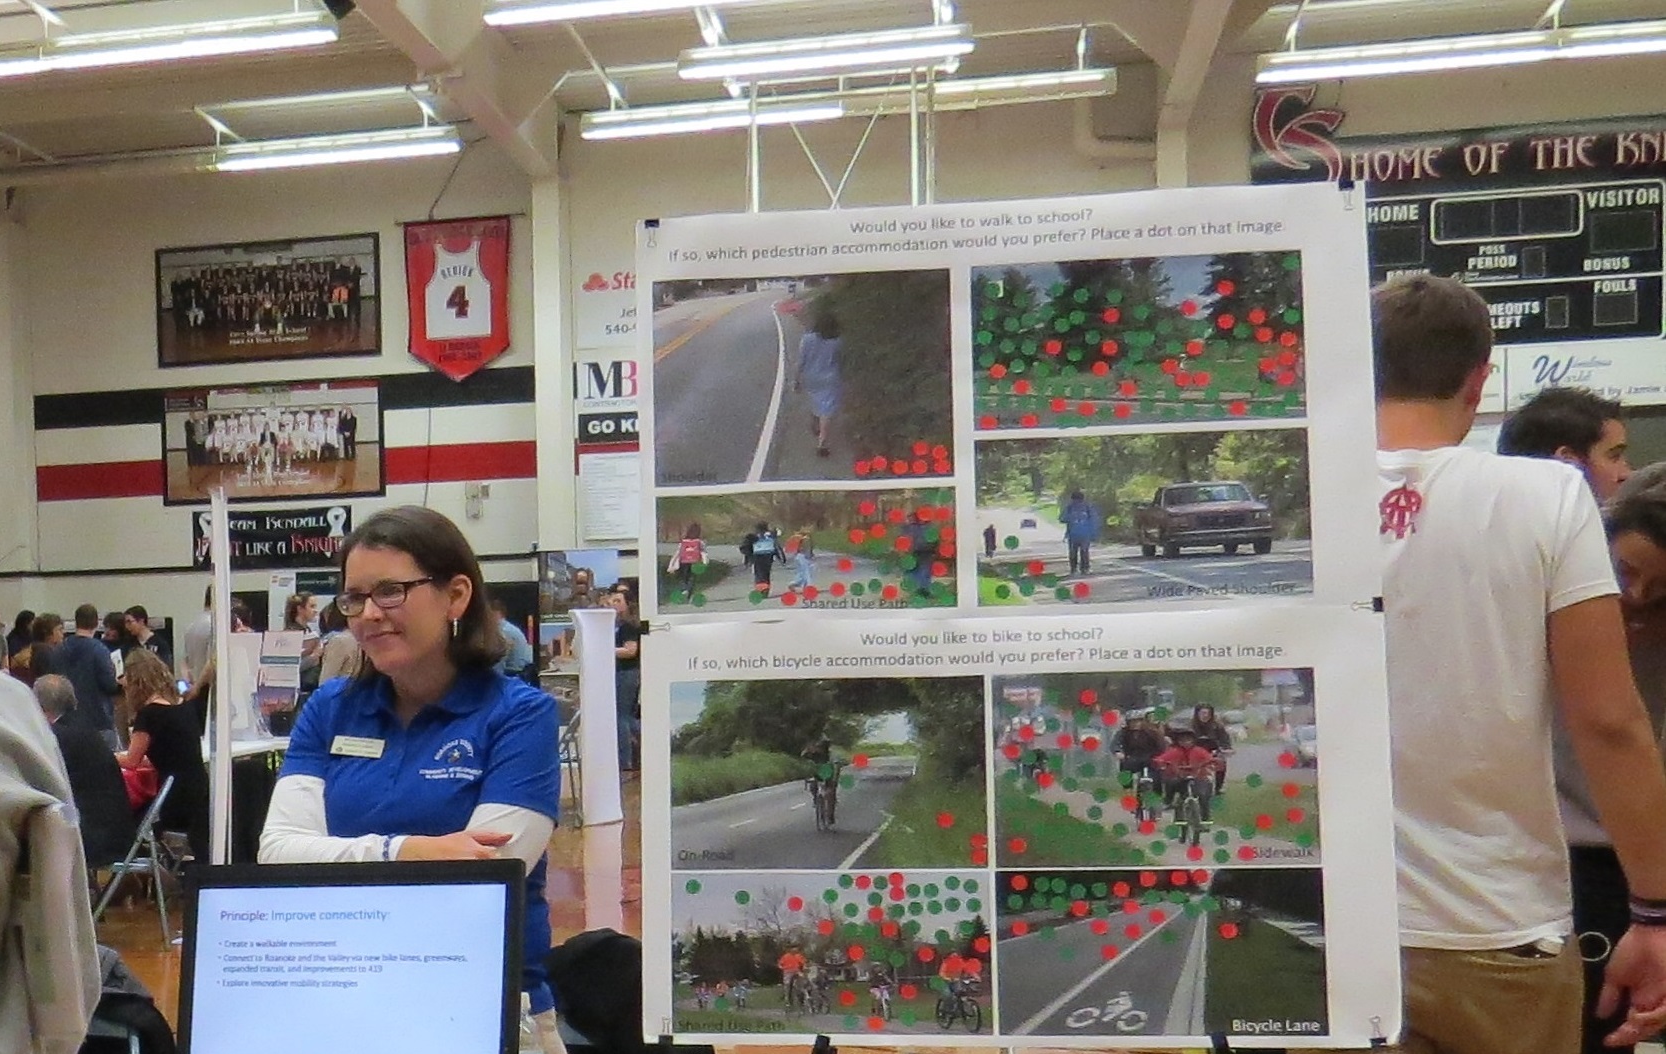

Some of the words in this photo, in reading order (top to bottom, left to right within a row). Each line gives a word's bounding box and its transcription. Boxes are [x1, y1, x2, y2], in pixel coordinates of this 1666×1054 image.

[1350, 146, 1444, 182] HOME
[1463, 141, 1510, 176] OF
[1530, 135, 1598, 171] THE
[1586, 188, 1660, 209] VISITOR
[851, 220, 897, 234] Would
[901, 219, 928, 234] you
[932, 216, 956, 230] like
[960, 217, 974, 229] to
[980, 213, 1013, 228] walk
[1018, 214, 1032, 226] to
[1037, 208, 1093, 223] school?
[1367, 204, 1420, 223] HOME
[668, 250, 679, 262] If
[683, 251, 702, 263] so,
[706, 246, 748, 261] which
[752, 244, 828, 262] pedestrian
[832, 238, 948, 255] accommodation
[952, 235, 997, 249] would
[1002, 234, 1028, 249] you
[1033, 229, 1087, 247] prefer?
[1091, 226, 1131, 241] Place
[1134, 228, 1143, 239] a
[1148, 224, 1173, 238] dot
[1178, 225, 1197, 237] on
[1201, 221, 1232, 236] that
[1478, 244, 1506, 256] POSS
[1467, 254, 1518, 270] PERIOD
[1583, 256, 1631, 271] BONUS
[1593, 278, 1637, 293] FOULS
[446, 285, 470, 319] 4
[1487, 301, 1540, 316] MEOUTS
[605, 323, 636, 335] 540-
[588, 420, 615, 434] GO
[229, 519, 257, 530] EAM
[246, 540, 271, 556] LIKE
[277, 540, 286, 555] A
[1148, 584, 1183, 597] Wide
[802, 598, 845, 610] Shared
[850, 598, 875, 610] Use
[880, 598, 908, 610] Path
[860, 632, 907, 646] Would
[911, 633, 938, 647] you
[942, 631, 967, 645] like
[972, 632, 987, 644] to
[992, 630, 1022, 643] bike
[1027, 631, 1042, 642] to
[1047, 627, 1104, 642] school?
[688, 657, 699, 670] If
[702, 659, 722, 671] so,
[726, 656, 768, 669] which
[773, 654, 821, 671] bicycle
[826, 652, 944, 667] accommodation
[948, 651, 994, 666] would
[999, 652, 1026, 666] you
[1031, 649, 1084, 666] prefer?
[1089, 647, 1129, 660] Place
[1133, 649, 1142, 659] a
[1146, 646, 1173, 659] dot
[1177, 647, 1196, 658] on
[1201, 644, 1232, 657] that
[219, 910, 269, 922] Principle:
[271, 910, 317, 922] Improve
[224, 940, 249, 948] Create
[256, 940, 288, 948] walkable
[223, 954, 254, 962] Connect
[255, 954, 263, 962] to
[265, 954, 296, 962] Roanoke
[298, 954, 312, 962] and
[313, 954, 326, 962] the
[328, 954, 350, 963] Valley
[351, 954, 362, 962] via
[382, 954, 398, 962] bike
[223, 965, 258, 974] expanded
[287, 965, 302, 973] and
[303, 965, 357, 974] improvements
[358, 965, 366, 973] to
[368, 965, 383, 973] 419
[222, 979, 249, 988] Explore
[251, 979, 289, 987] innovative
[291, 979, 319, 989] mobility
[321, 979, 358, 989] strategies
[1232, 1019, 1283, 1034] Bicycle
[1286, 1019, 1321, 1032] Lane
